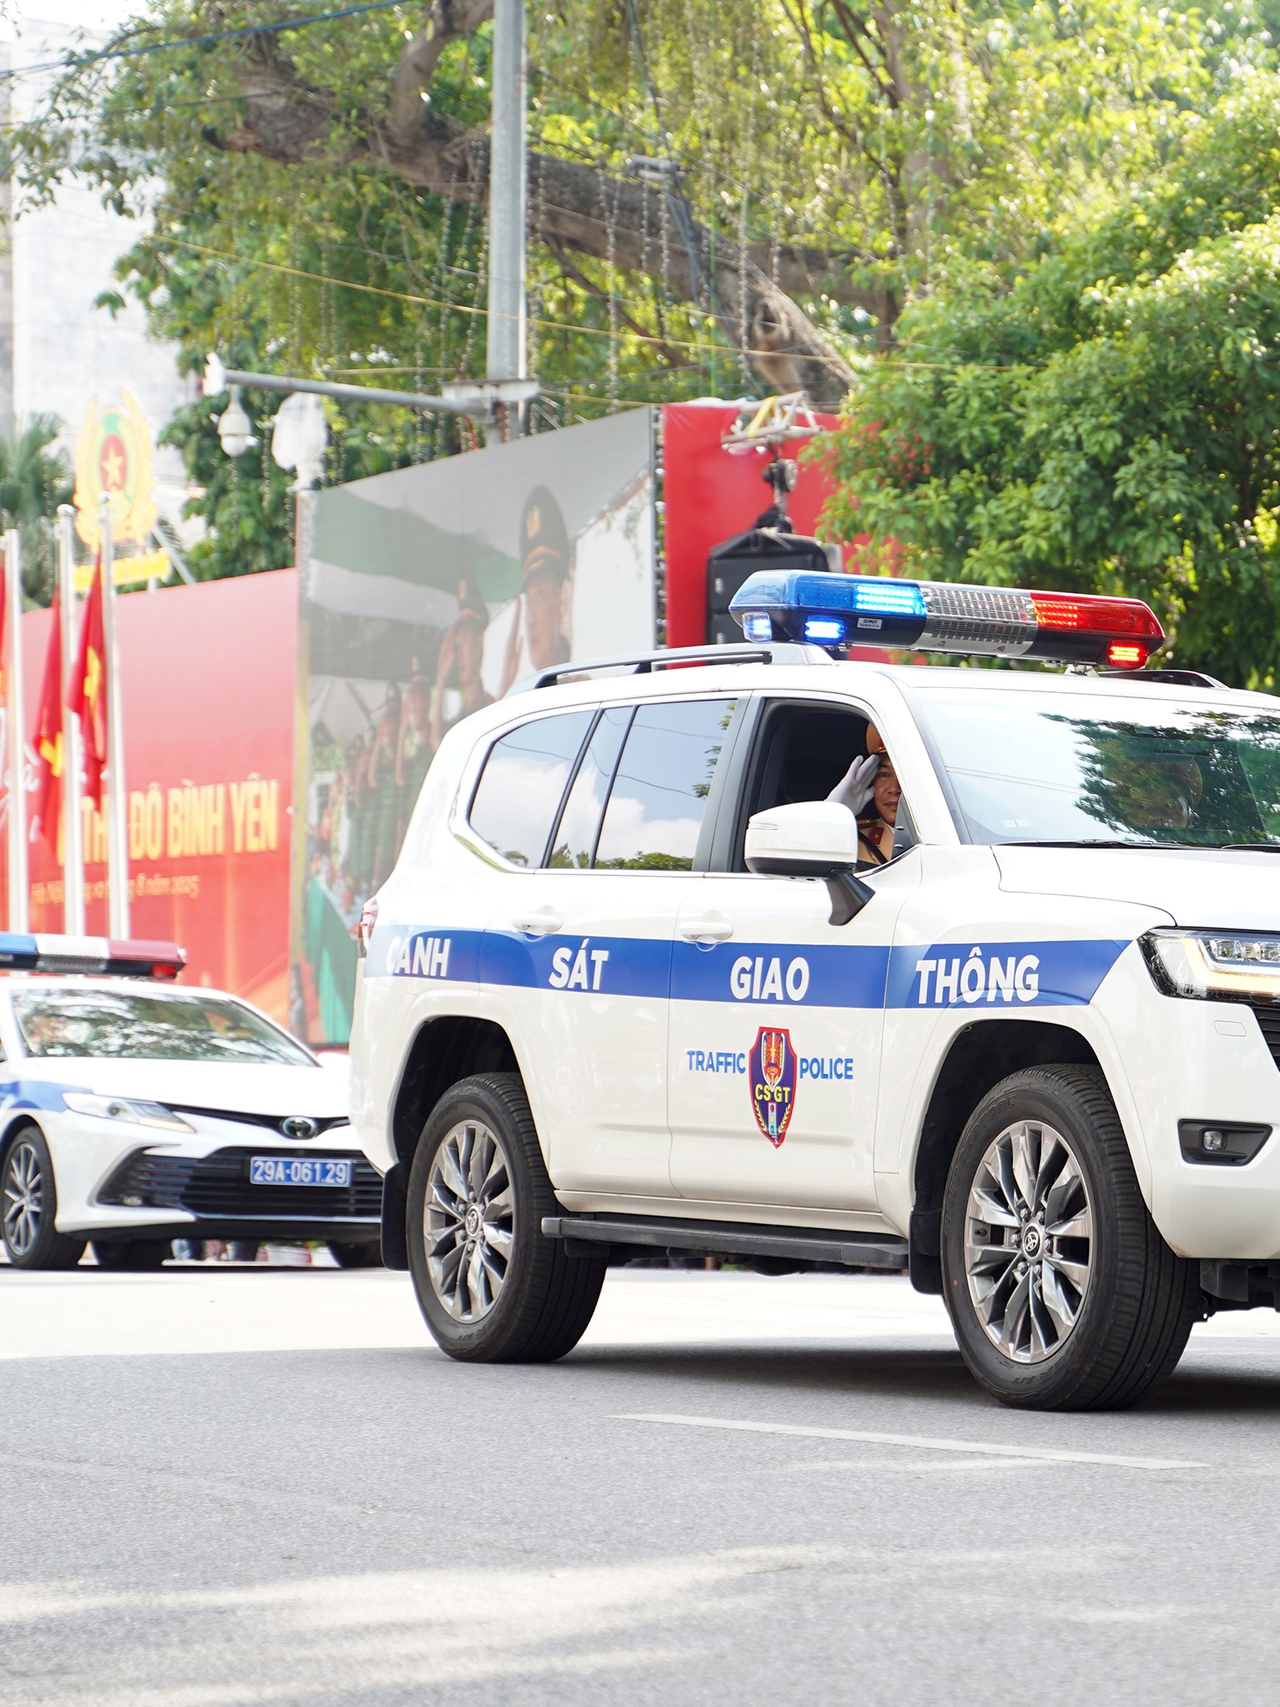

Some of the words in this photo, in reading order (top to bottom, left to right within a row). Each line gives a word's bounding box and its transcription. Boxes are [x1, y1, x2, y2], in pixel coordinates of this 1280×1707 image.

[129, 782, 163, 861] ĐÔ
[167, 778, 224, 859] BÌNH
[229, 771, 279, 853] YÊN
[171, 875, 199, 899] 2025
[548, 937, 609, 991] SÁT
[730, 955, 810, 1002] GIAO
[915, 946, 1040, 1005] THÔNG
[686, 1050, 746, 1075] TRAFFIC
[799, 1057, 854, 1080] POLICE
[755, 1083, 791, 1103] CSGT
[253, 1161, 348, 1184] 29A-061.29
